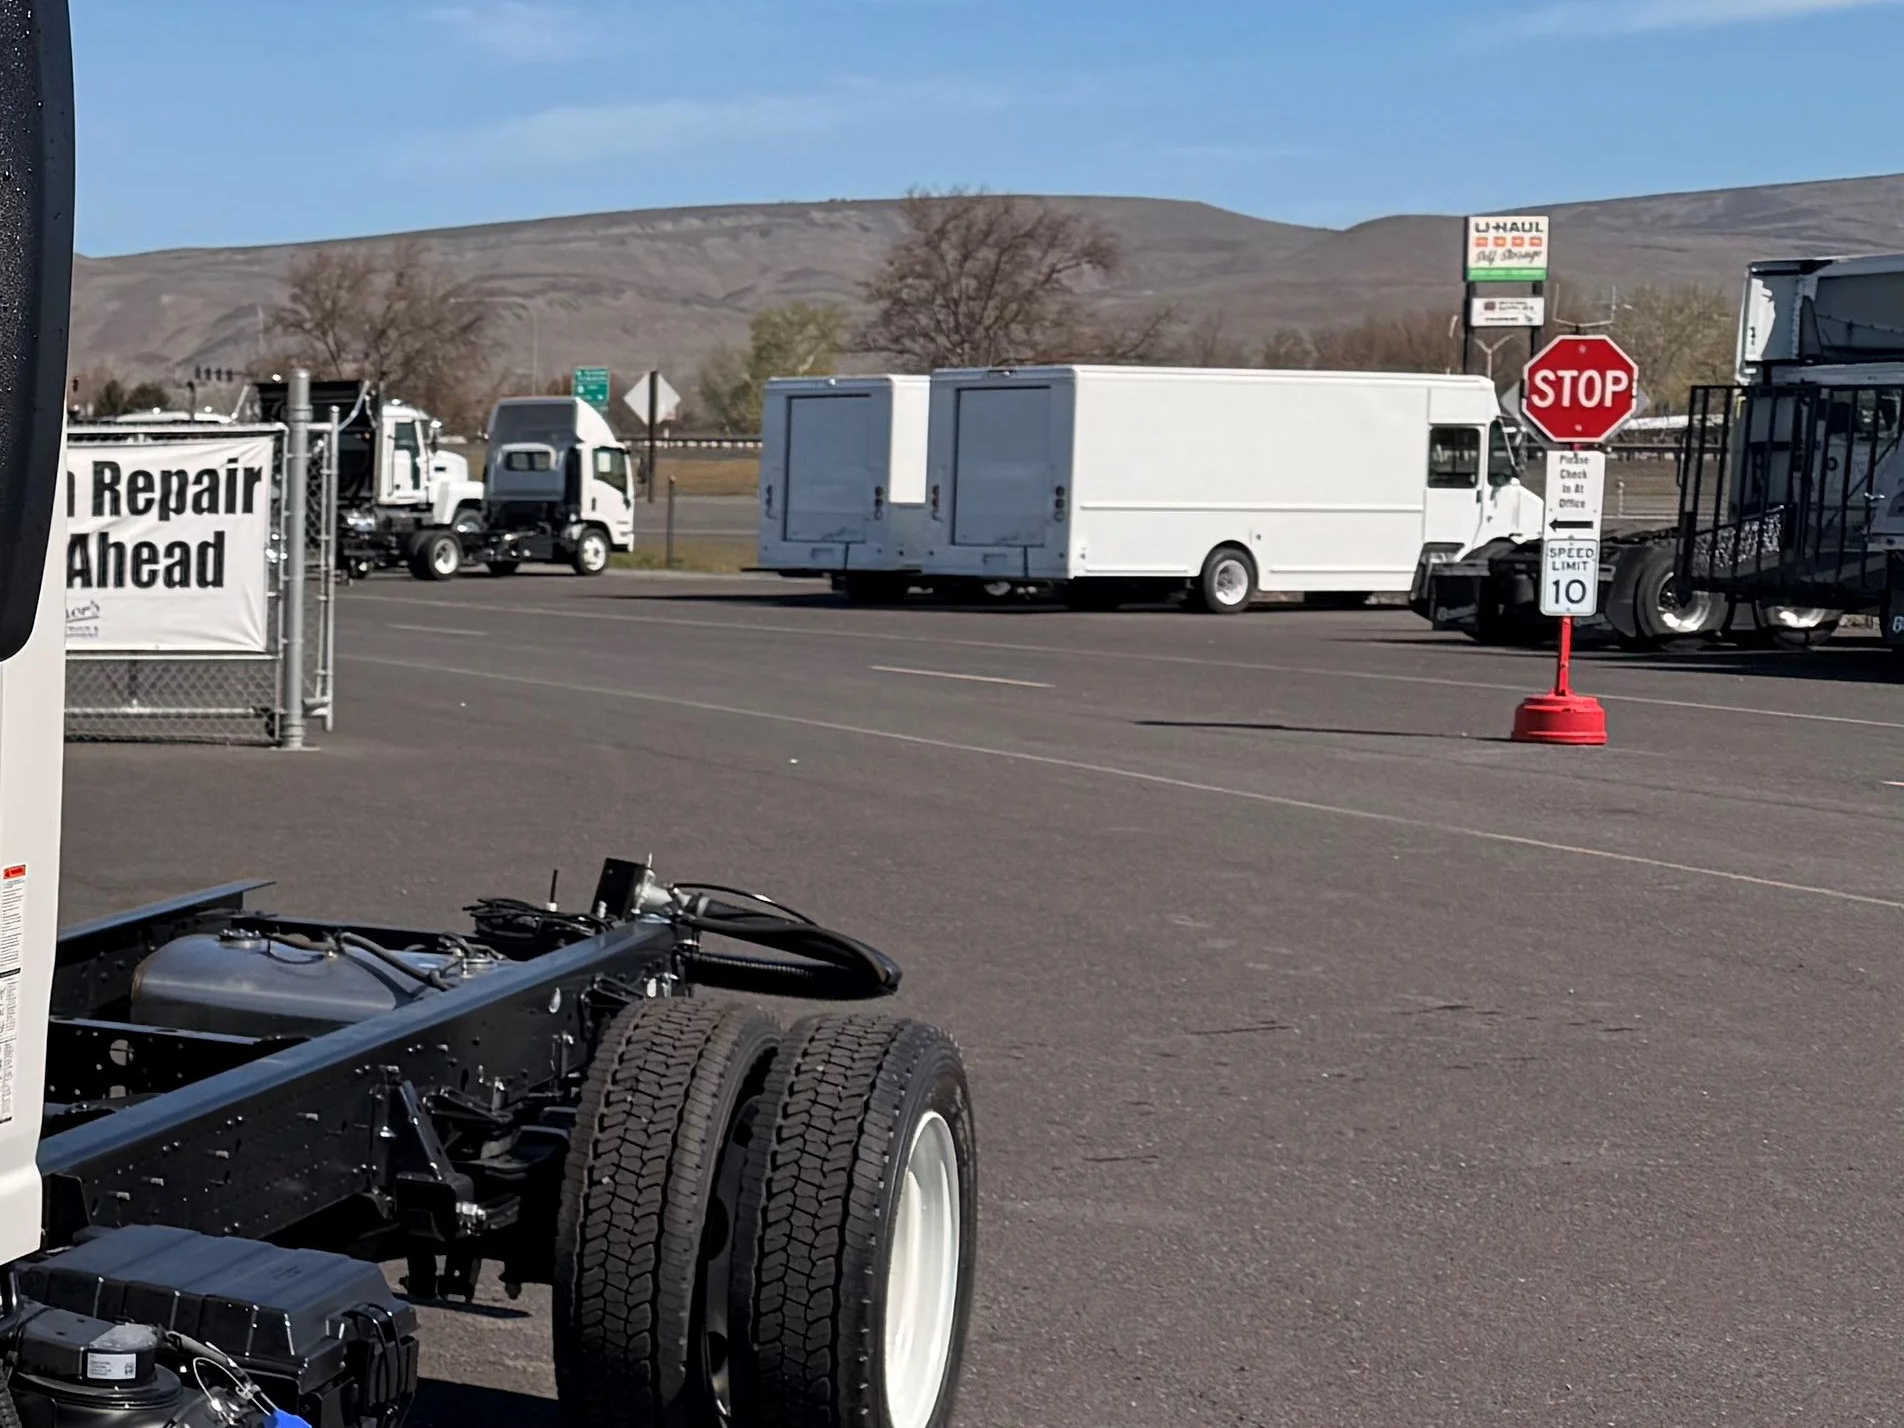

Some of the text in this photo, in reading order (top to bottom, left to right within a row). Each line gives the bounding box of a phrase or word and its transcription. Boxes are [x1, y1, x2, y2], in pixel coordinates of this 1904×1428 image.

[1474, 221, 1544, 233] U-HAUL
[1530, 369, 1629, 408] STOP
[1559, 469, 1588, 480] Check
[92, 457, 263, 521] Repair
[1558, 498, 1586, 509] Office
[67, 530, 225, 588] Ahead
[1549, 548, 1594, 559] SPEED
[1552, 561, 1589, 571] LIMIT
[1552, 578, 1587, 604] 10
